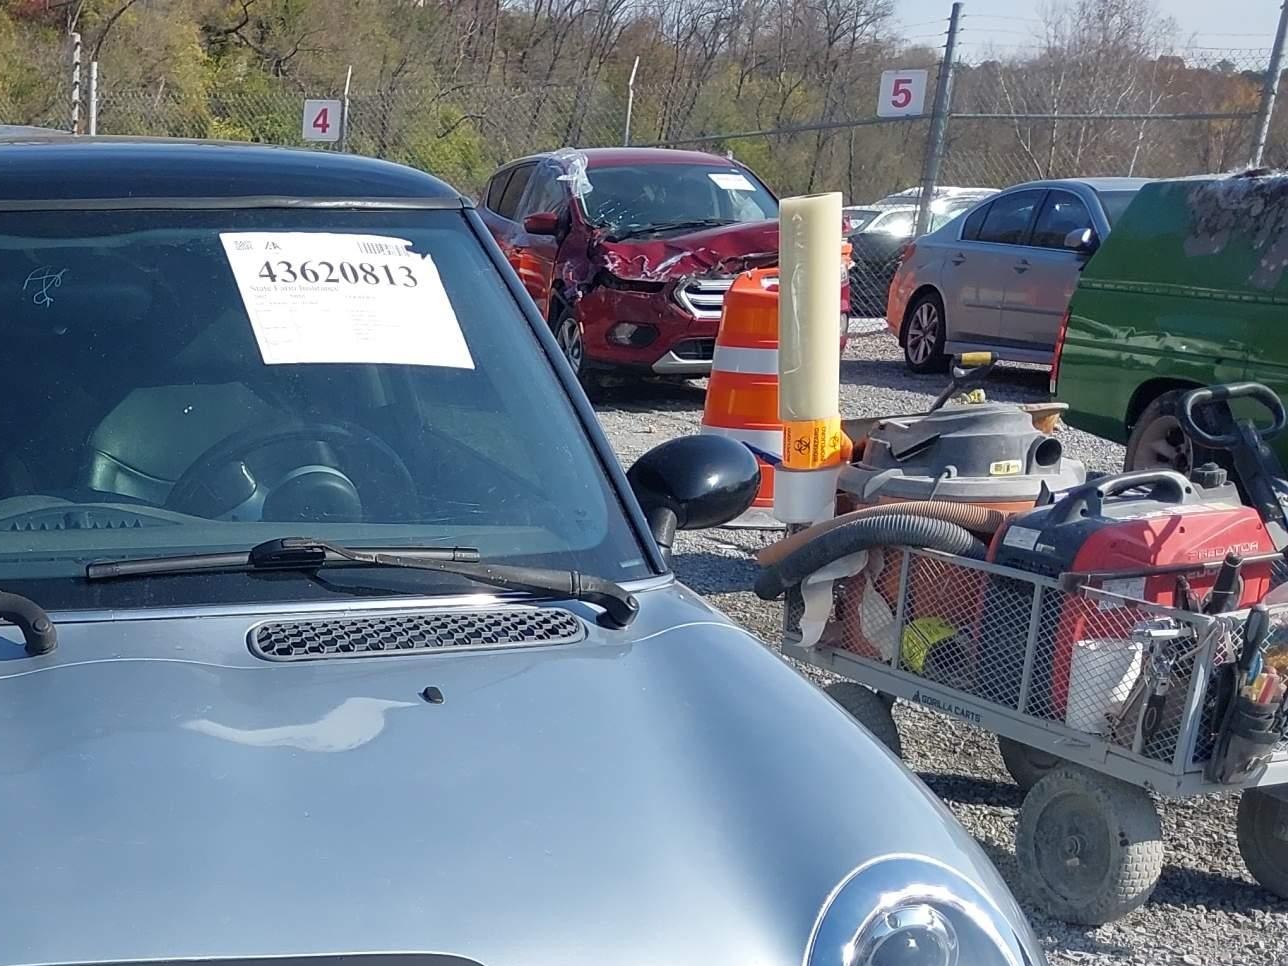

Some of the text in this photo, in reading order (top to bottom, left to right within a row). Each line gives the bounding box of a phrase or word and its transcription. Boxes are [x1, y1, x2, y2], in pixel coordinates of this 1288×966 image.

[891, 78, 913, 108] 5
[312, 107, 330, 134] 4
[258, 259, 419, 288] 43620813
[1188, 541, 1259, 561] PREDATOR
[921, 694, 981, 723] GORILLA CARTS
